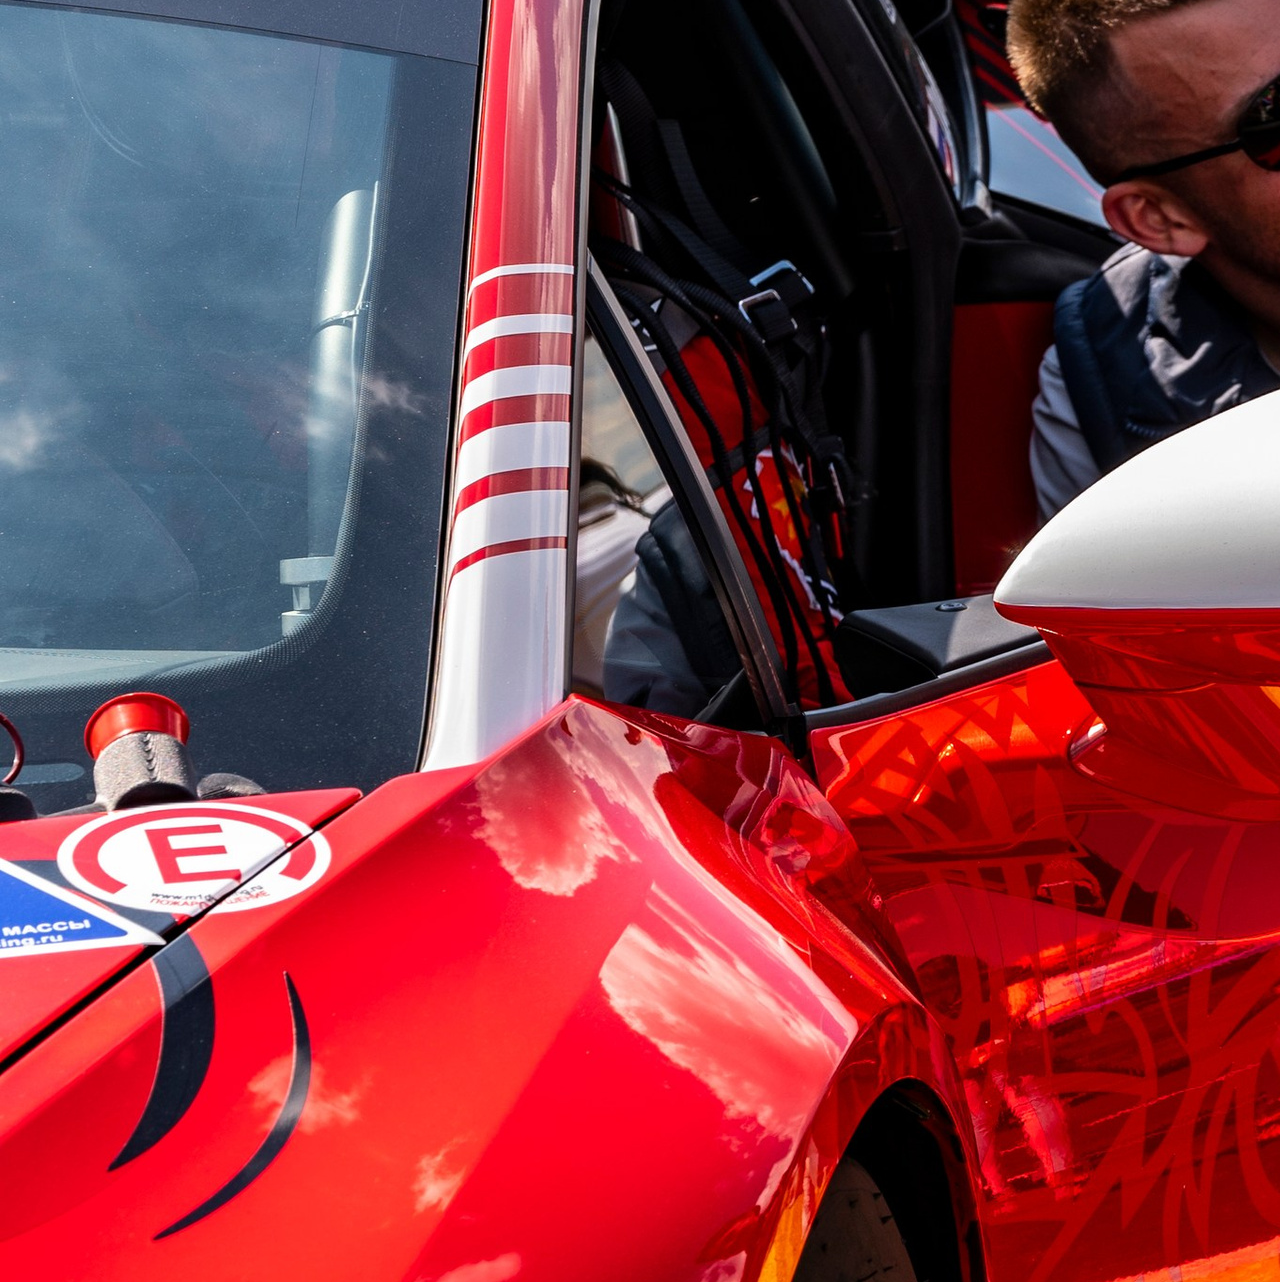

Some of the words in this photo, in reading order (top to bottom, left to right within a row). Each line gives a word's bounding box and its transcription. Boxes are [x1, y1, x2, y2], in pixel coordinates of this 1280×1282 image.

[145, 824, 242, 884] E
[2, 919, 91, 936] МАССЫ
[0, 934, 63, 948] ing.ru
